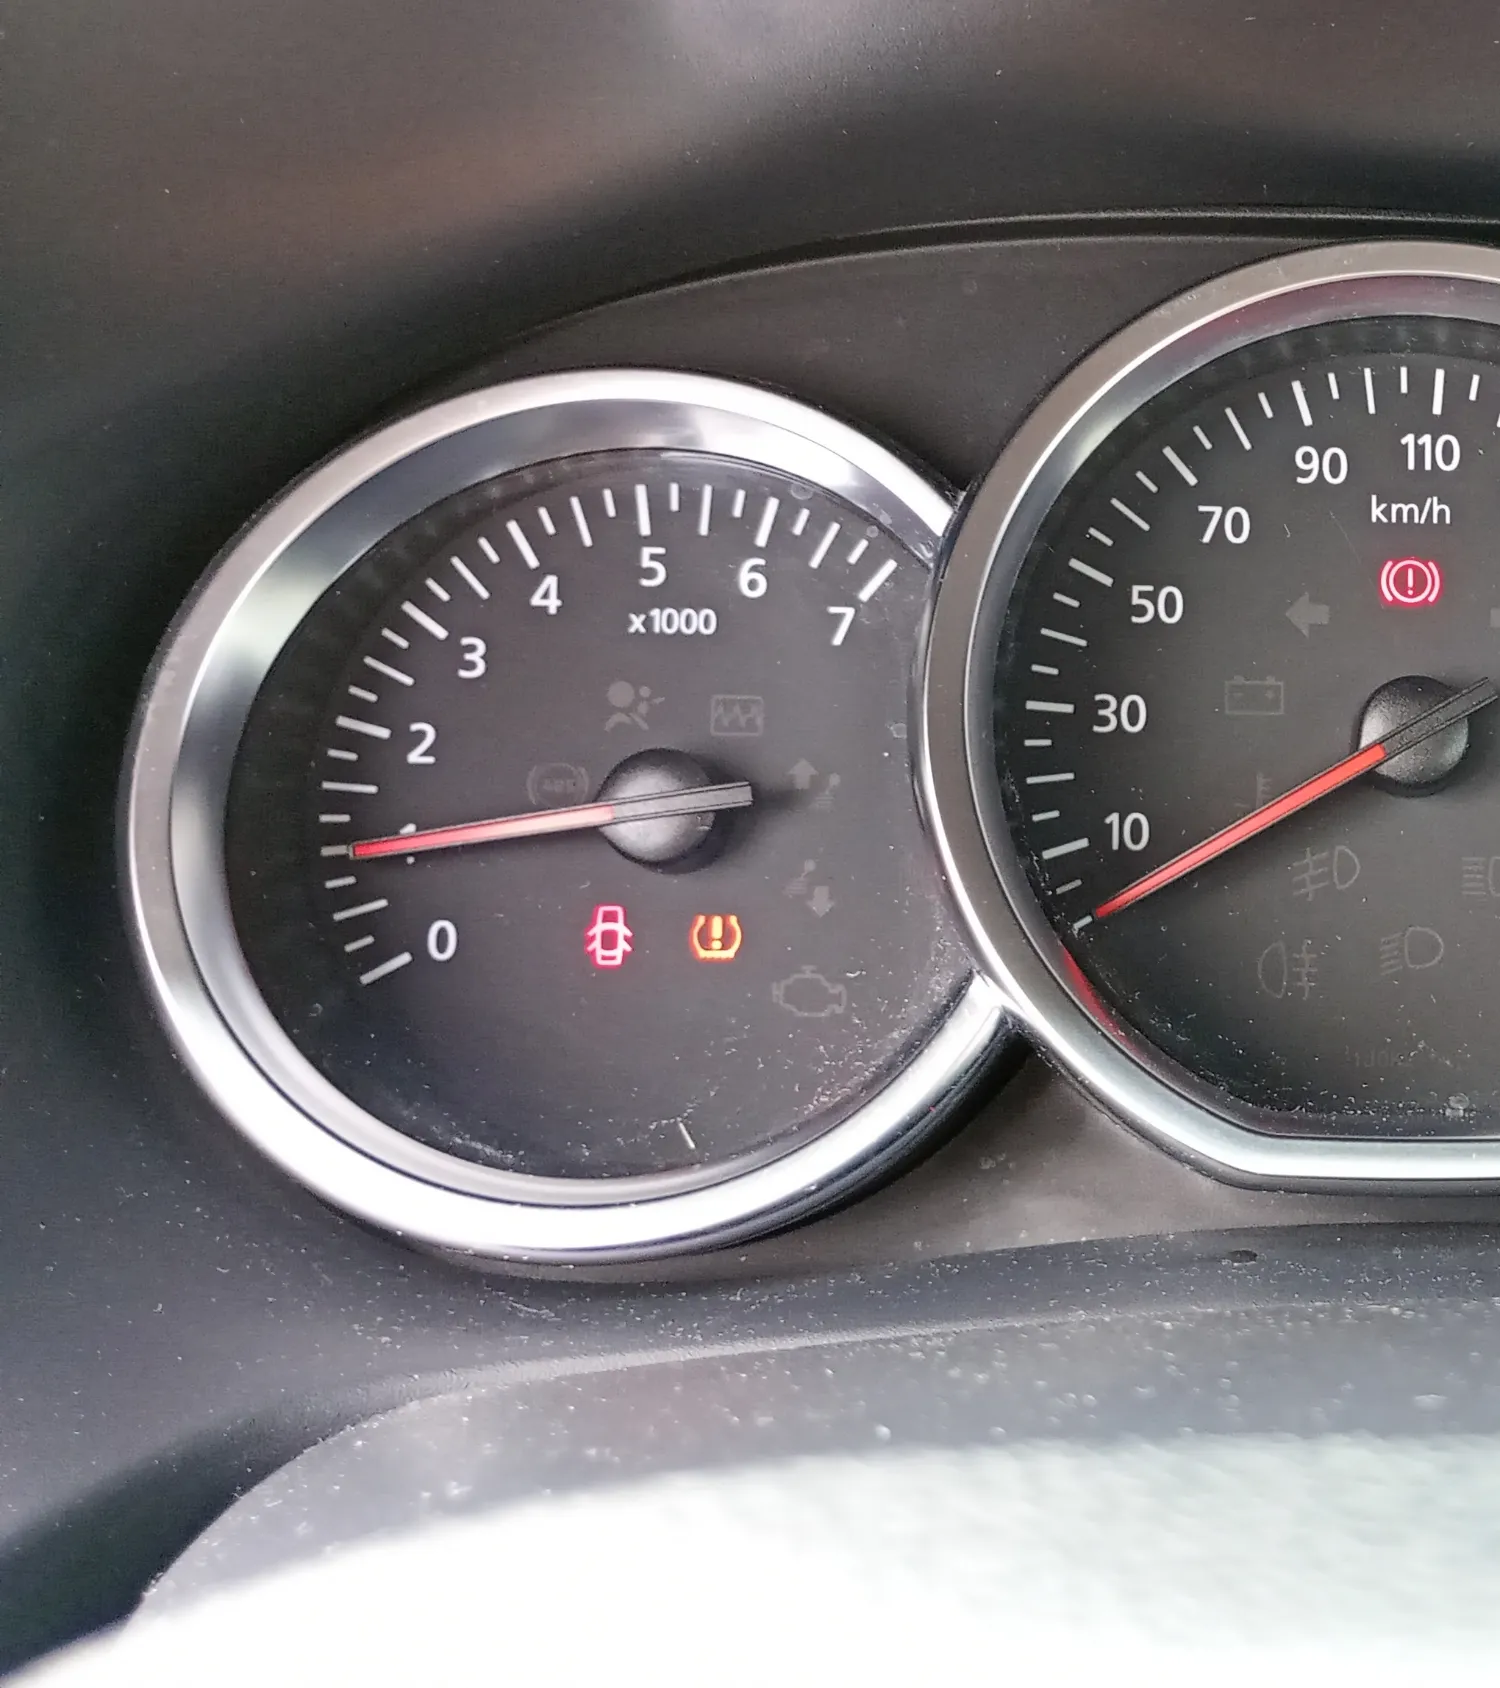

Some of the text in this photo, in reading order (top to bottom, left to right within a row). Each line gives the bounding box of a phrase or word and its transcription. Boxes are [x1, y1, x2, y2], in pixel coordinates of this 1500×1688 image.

[1294, 445, 1348, 485] 90
[1400, 433, 1461, 472] 110
[1197, 505, 1251, 544] 70
[1370, 494, 1451, 525] km/h
[639, 546, 667, 587] 5
[738, 557, 768, 598] 6
[530, 574, 562, 615] 4
[1131, 585, 1184, 624] 50
[628, 607, 717, 635] x1000
[827, 606, 856, 646] 7
[458, 636, 486, 679] 3
[1093, 693, 1147, 733] 30
[407, 722, 436, 764] 2
[1104, 812, 1150, 851] 10
[427, 919, 457, 961] 0
